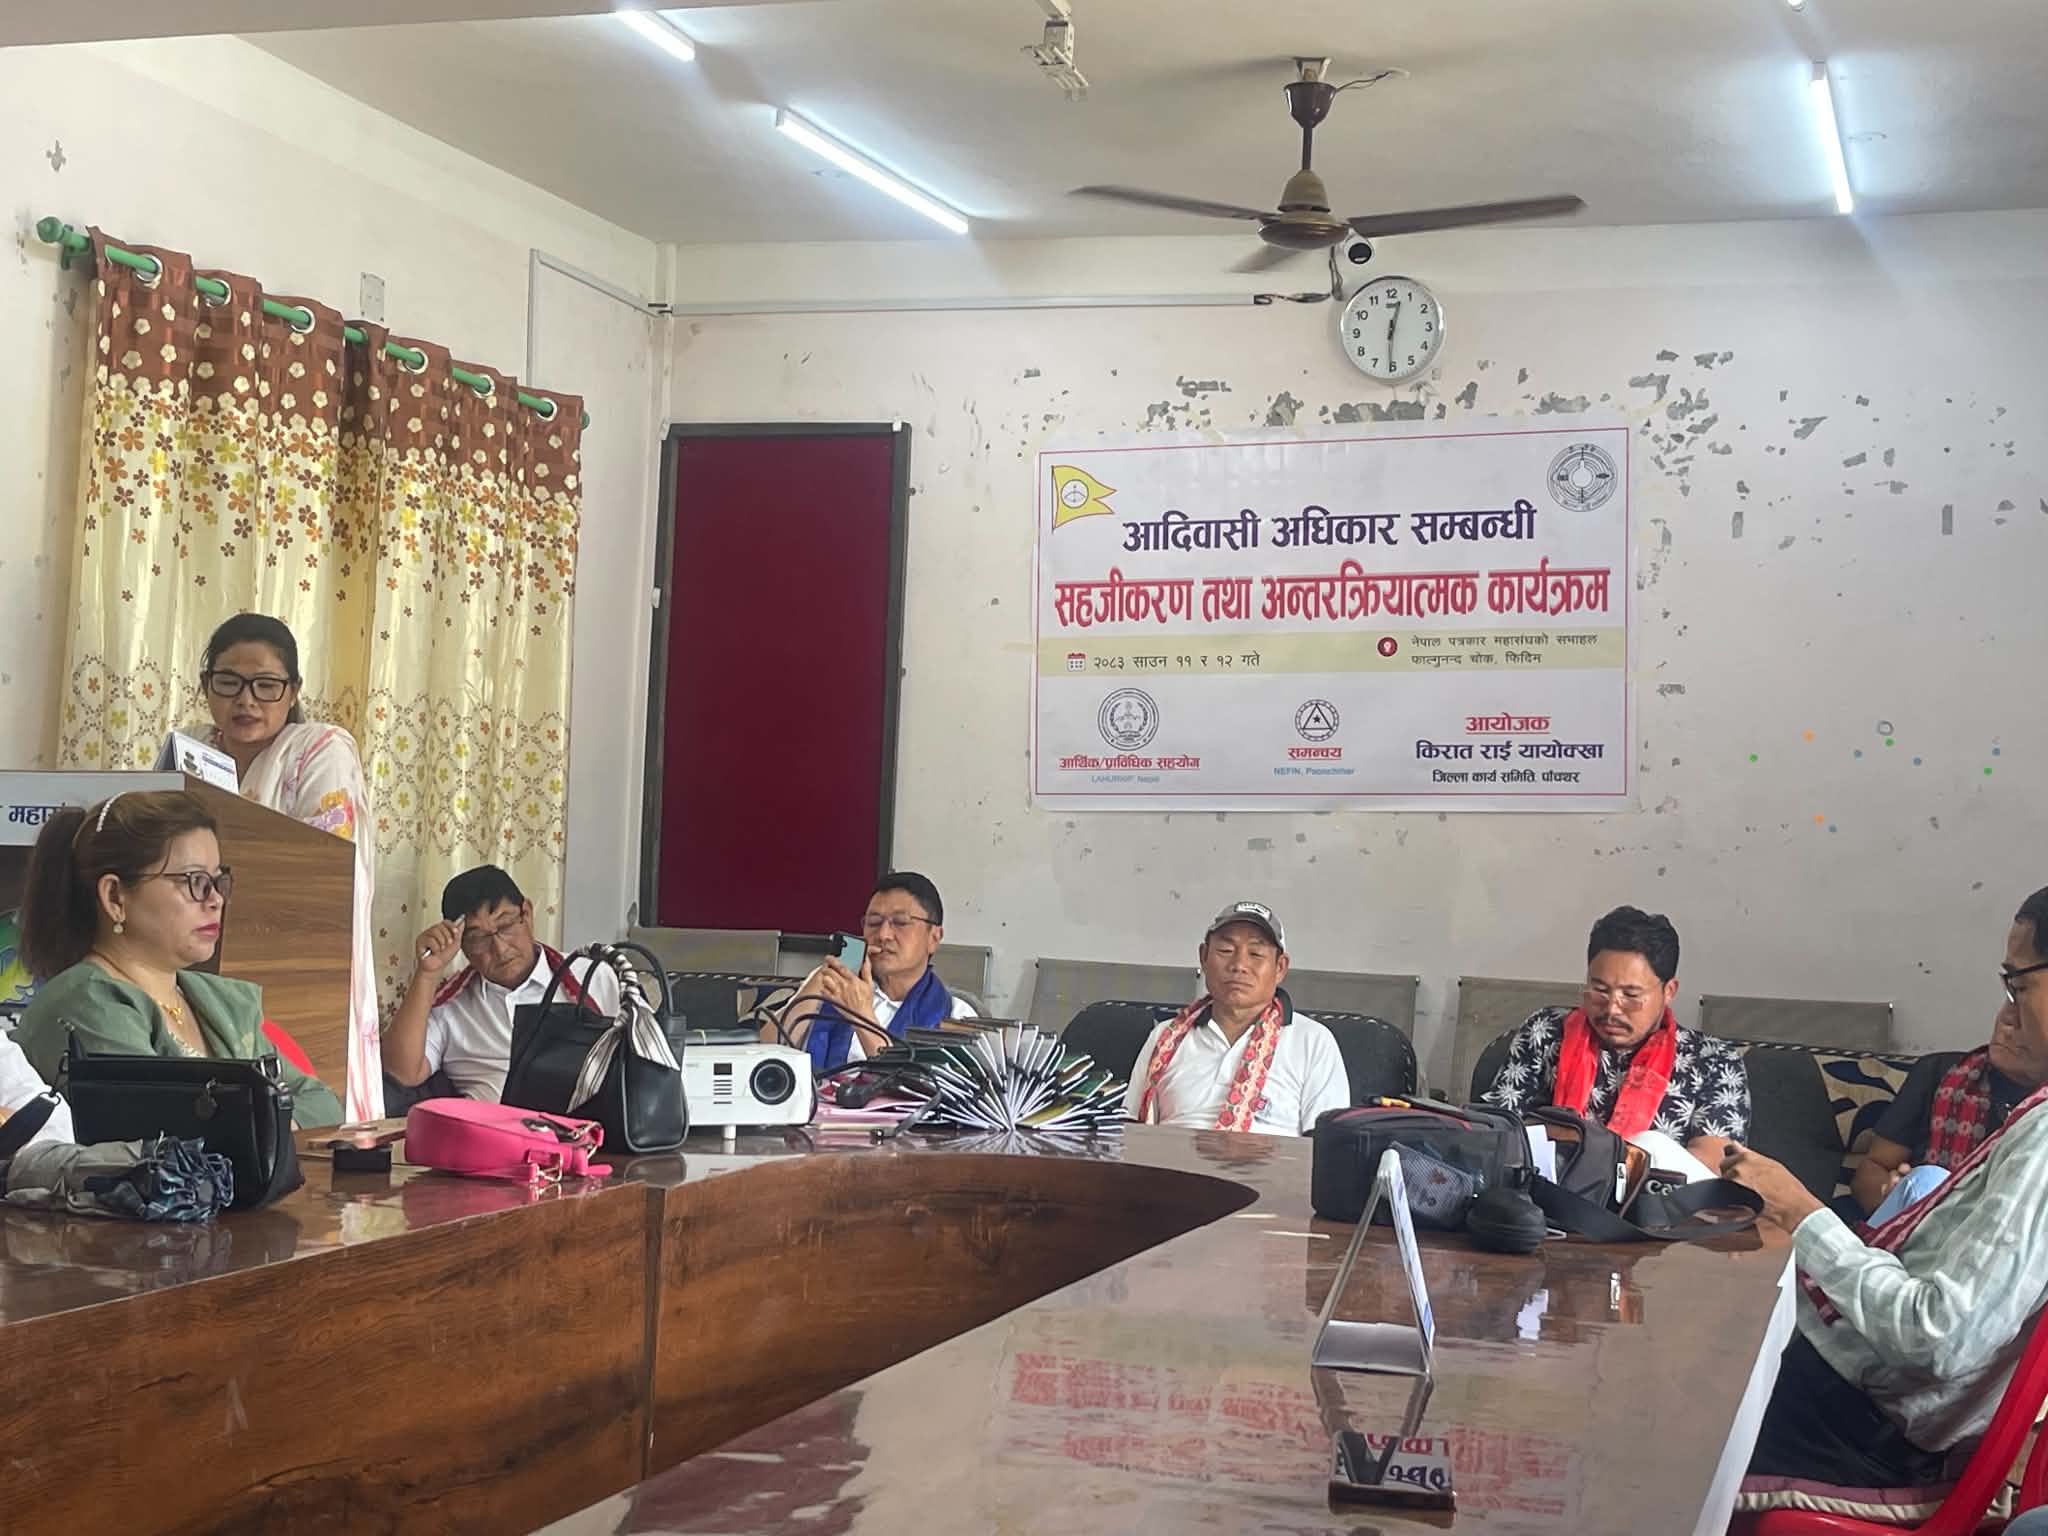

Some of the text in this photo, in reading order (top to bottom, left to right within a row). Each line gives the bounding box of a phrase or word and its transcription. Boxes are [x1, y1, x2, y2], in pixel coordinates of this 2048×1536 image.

[1386, 288, 1398, 299] 12
[1407, 292, 1413, 302] 1
[1369, 295, 1379, 306] 11
[1420, 303, 1428, 314] 2
[1355, 310, 1369, 321] 10
[1425, 321, 1433, 332] 3
[1352, 328, 1361, 339] 9
[1357, 346, 1365, 357] 8
[1420, 341, 1428, 351] 4
[1371, 358, 1379, 368] 7
[1407, 355, 1415, 366] 5
[1388, 361, 1397, 373] 6
[1122, 499, 1537, 551] आदिवासी अधिकार सम्बन्धी
[1054, 556, 1610, 627] सहजीकरण तथा अन्तरक्रियात्मक कार्यक्रम
[1411, 634, 1441, 648] नेपाल
[1448, 636, 1487, 647] पत्रकार
[1093, 650, 1261, 670] २०८३ साउन ११ र १२ गते
[1505, 650, 1542, 664] फिदिम
[1466, 712, 1551, 732] आयोजक
[1416, 739, 1604, 761] किरात राई यायोक्खा
[1432, 769, 1468, 783] जिल्ला
[1472, 769, 1496, 783] कार्य
